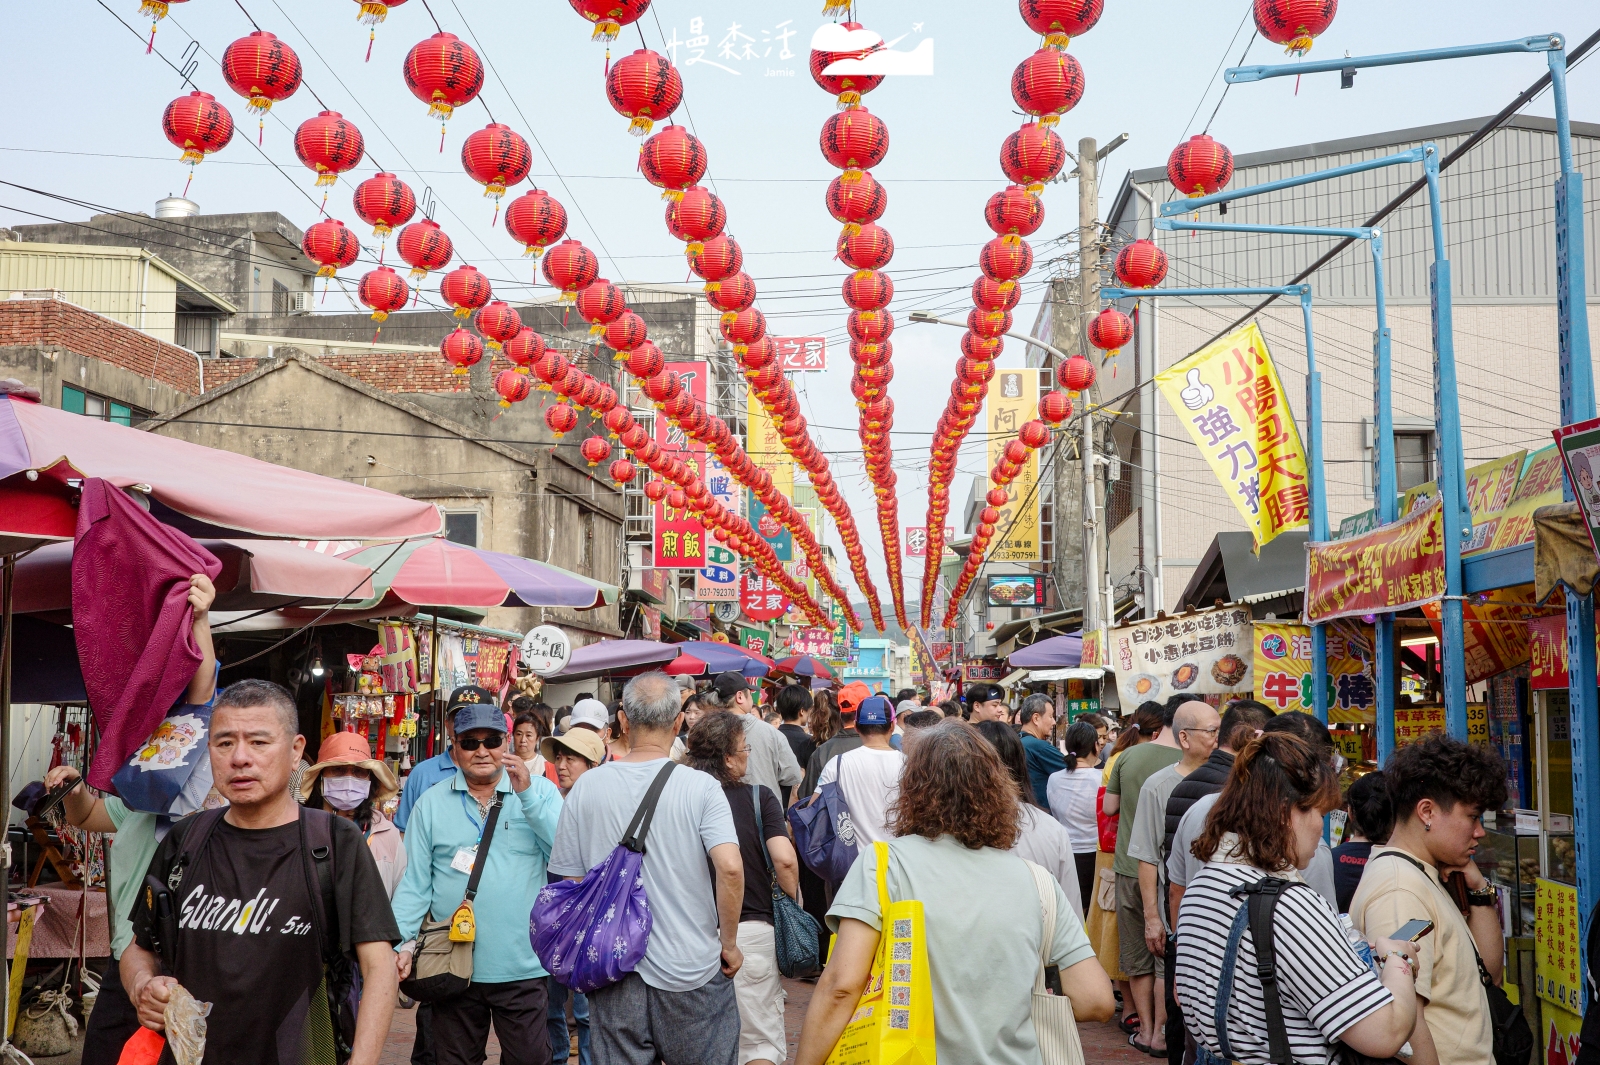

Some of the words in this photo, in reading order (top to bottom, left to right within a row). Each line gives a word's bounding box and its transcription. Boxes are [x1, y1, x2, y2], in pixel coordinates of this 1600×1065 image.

[1223, 346, 1309, 533] 小腸包大腸
[995, 540, 1032, 549] 宅配專線
[993, 551, 1036, 560] 0933-907591
[706, 568, 729, 582] 飲料
[700, 588, 735, 598] 037-792370
[747, 594, 783, 610] 之家
[1131, 610, 1249, 645] 白沙屯必吃美食
[793, 641, 831, 655] 飯麵館
[1144, 631, 1236, 664] 小惠紅豆餅
[1263, 672, 1375, 709] 牛奶棒
[1555, 724, 1566, 732] 35
[280, 916, 311, 935] 5th
[1557, 890, 1565, 972] 招牌雞腿捲
[1537, 974, 1543, 992] 30
[1547, 979, 1554, 998] 40
[1558, 983, 1565, 1003] 40
[1569, 988, 1577, 1009] 45
